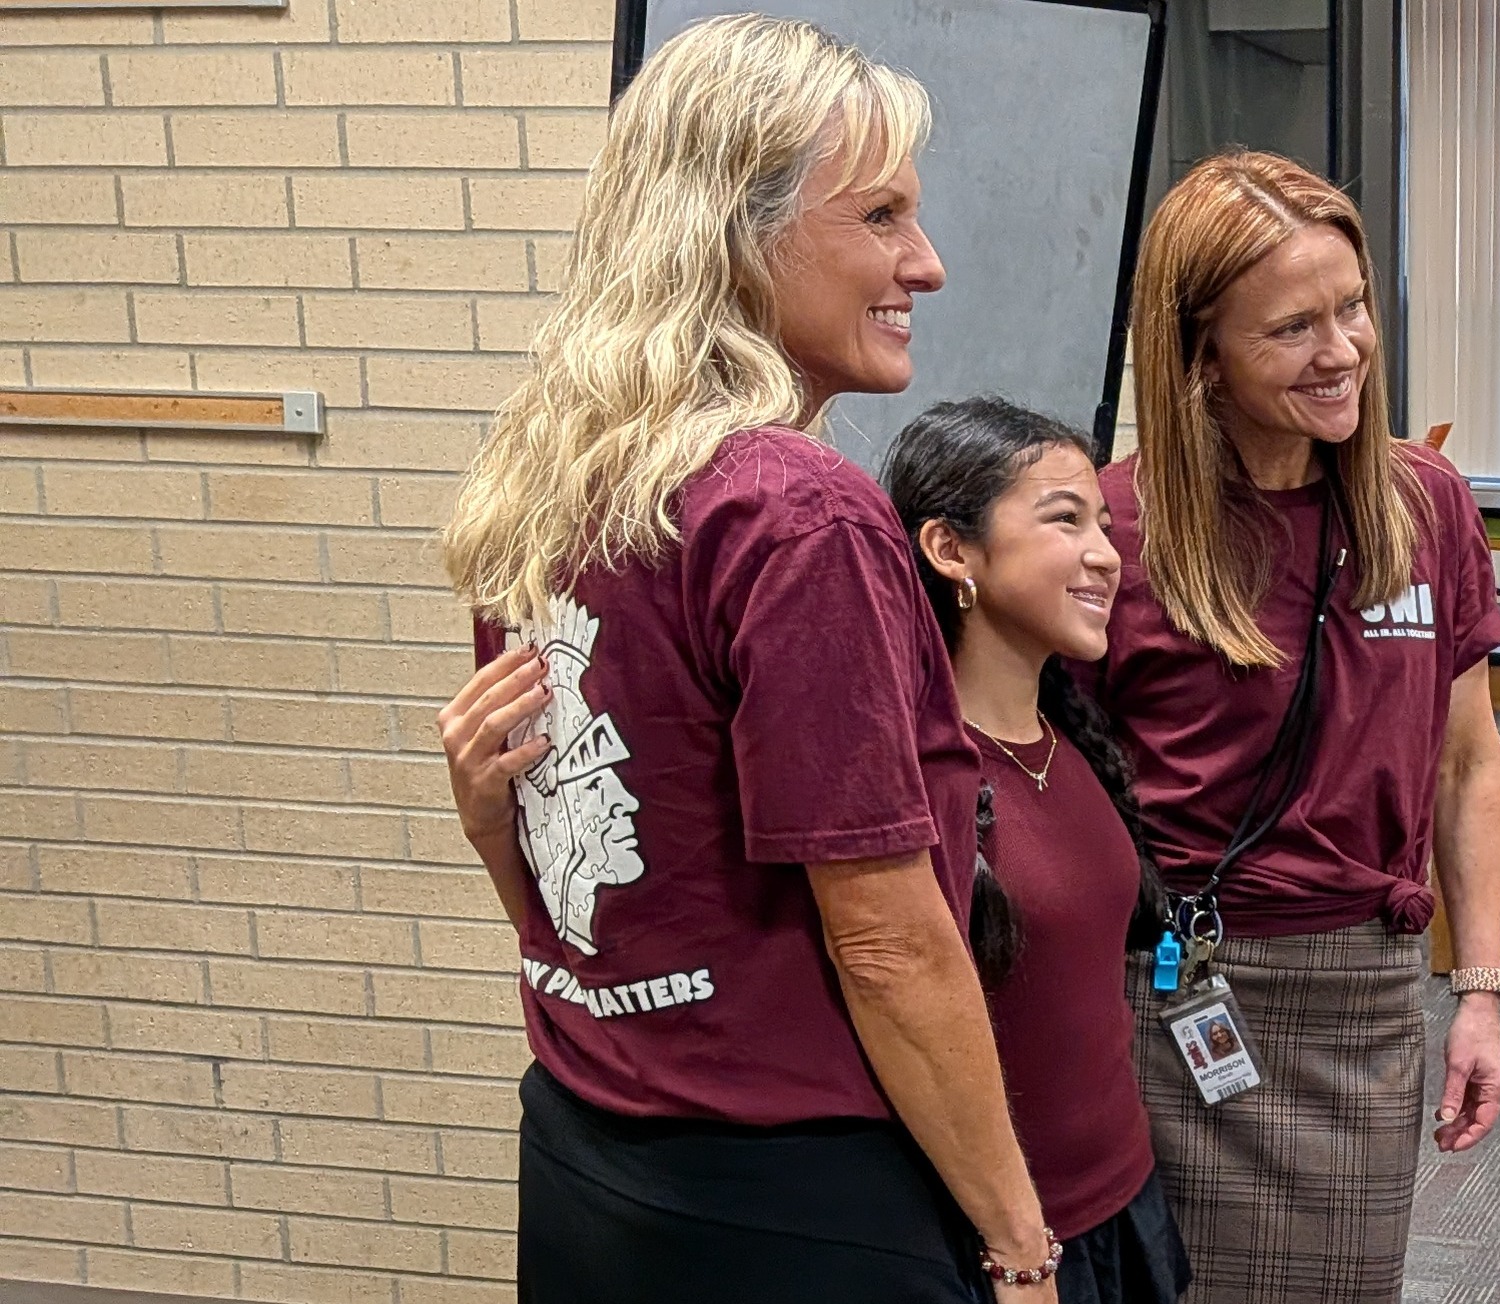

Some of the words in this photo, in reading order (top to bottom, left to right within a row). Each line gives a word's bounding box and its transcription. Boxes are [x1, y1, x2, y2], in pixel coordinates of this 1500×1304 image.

[1364, 629, 1379, 637] ALL
[1393, 629, 1406, 637] ALL
[582, 969, 714, 1018] MATTERS
[1199, 1058, 1246, 1082] MORRISON
